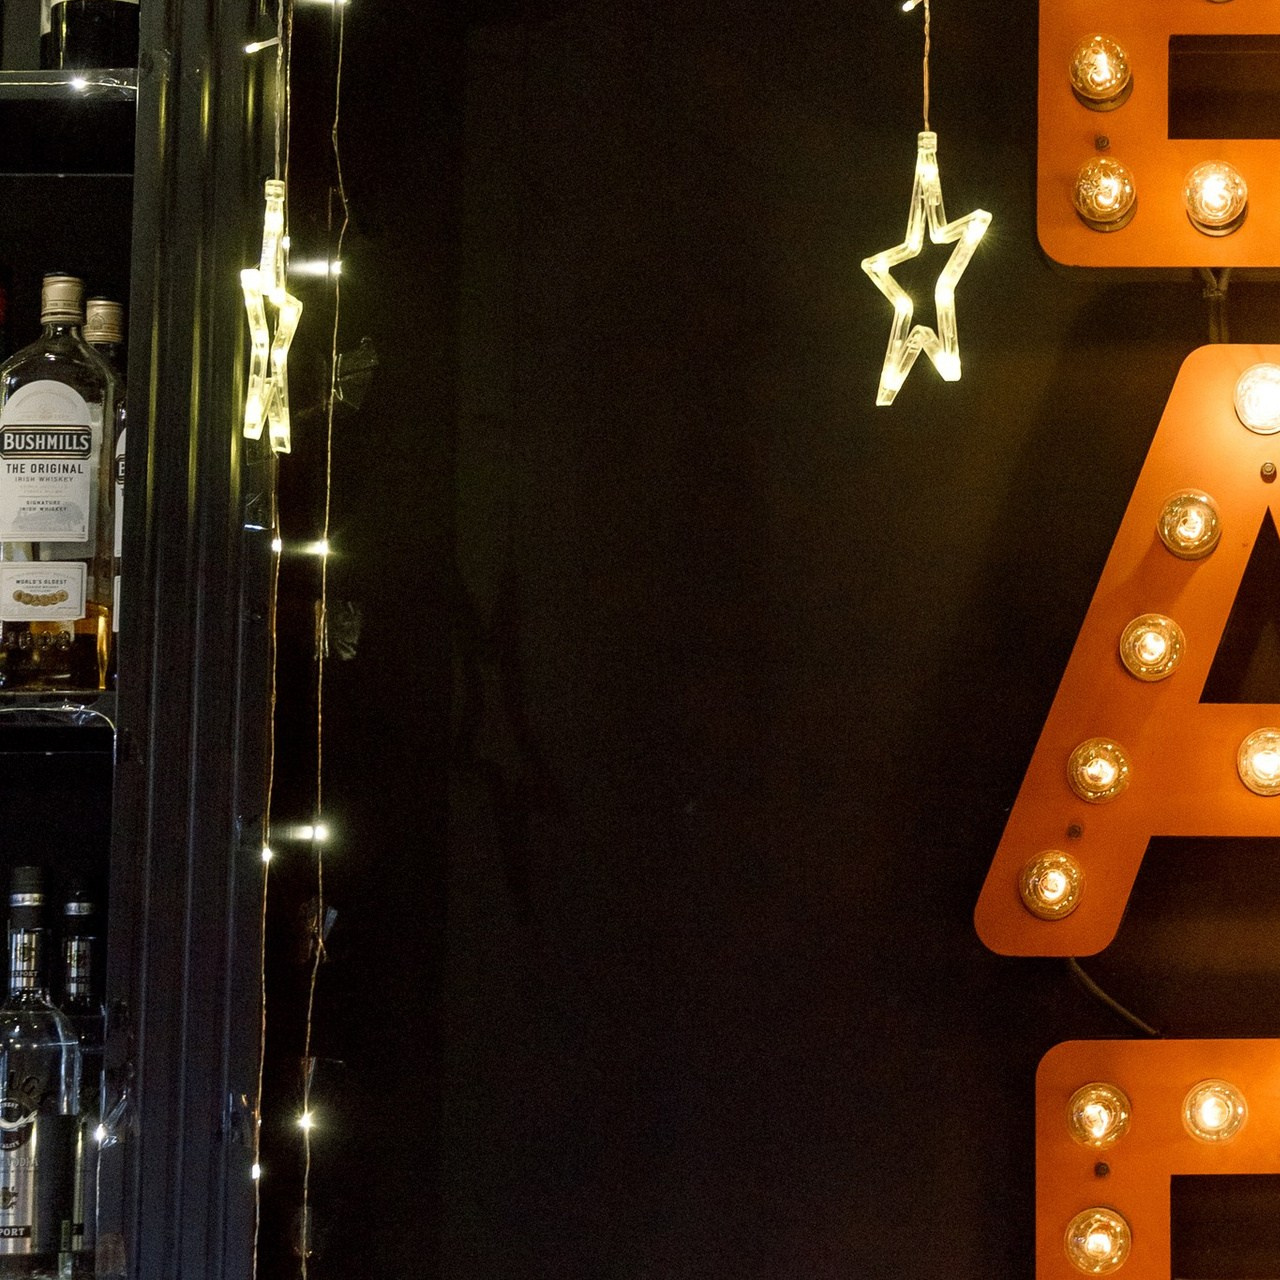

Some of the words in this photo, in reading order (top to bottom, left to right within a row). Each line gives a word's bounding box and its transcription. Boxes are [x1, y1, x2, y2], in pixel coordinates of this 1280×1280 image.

[3, 433, 90, 450] BUSHMILLS
[7, 463, 25, 473] THE
[30, 463, 84, 474] ORIGINAL
